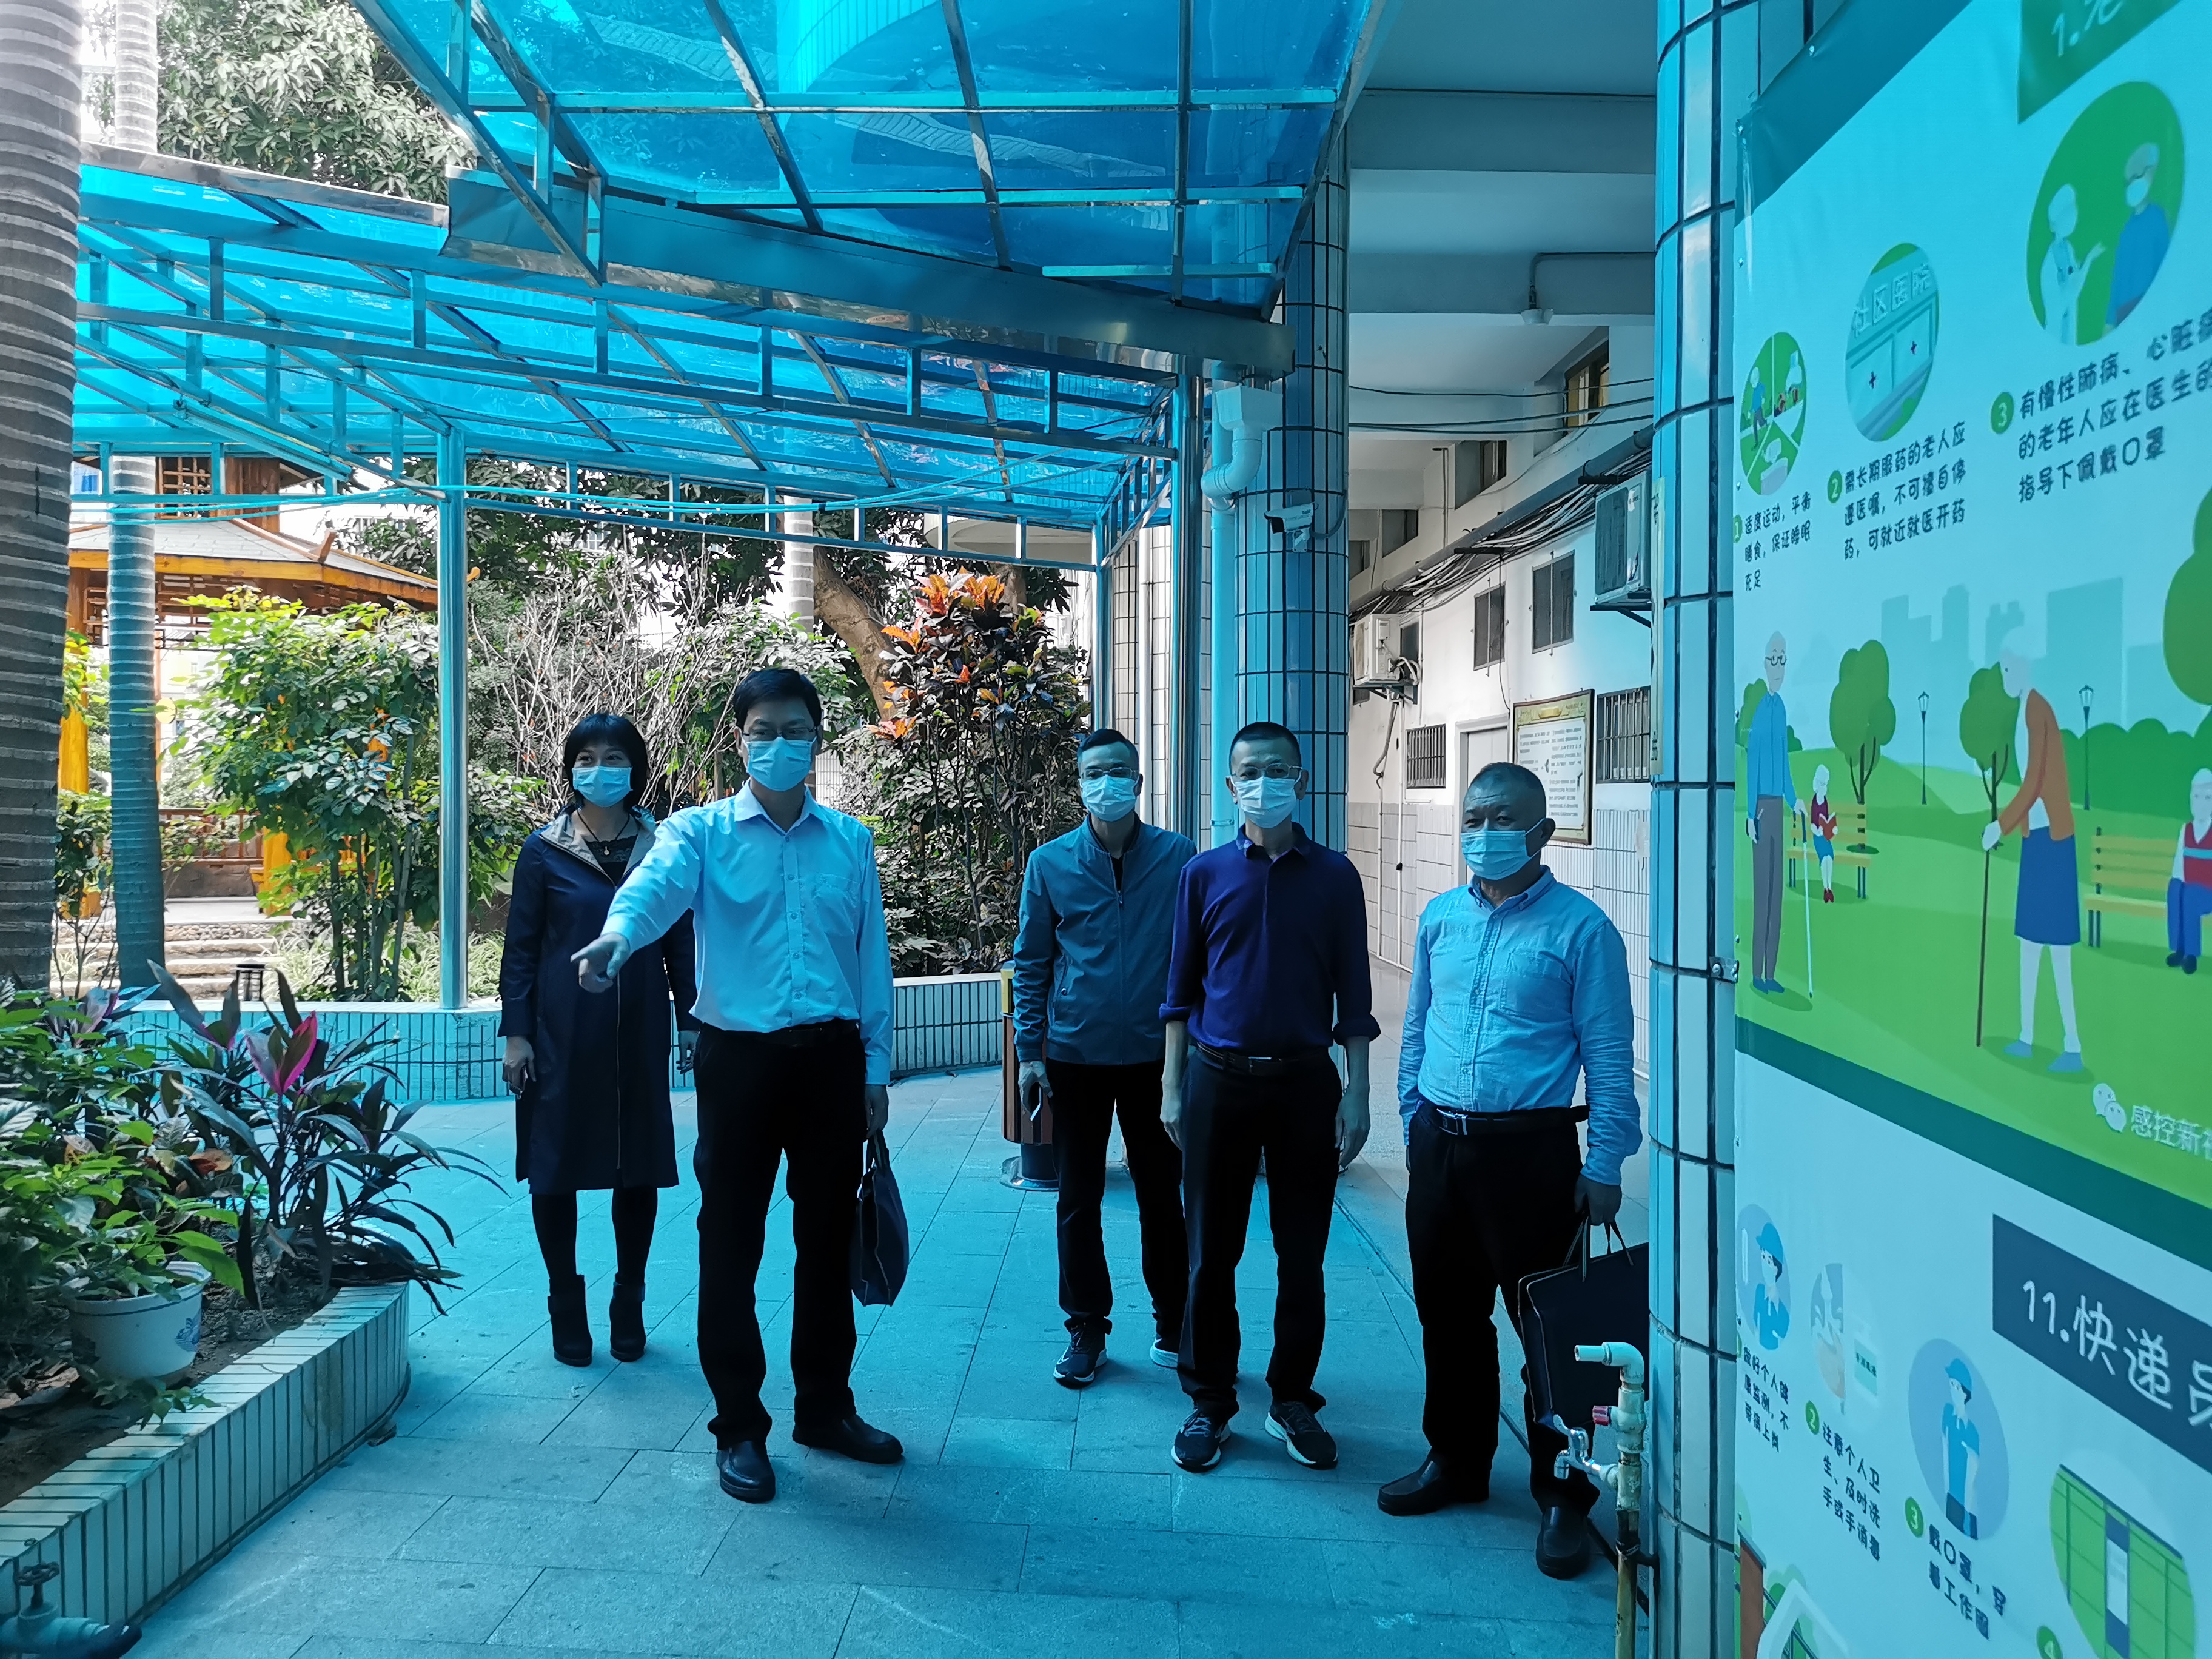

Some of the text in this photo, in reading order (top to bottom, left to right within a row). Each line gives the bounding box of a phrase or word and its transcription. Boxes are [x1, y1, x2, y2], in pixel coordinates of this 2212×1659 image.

[1852, 263, 1930, 338] 社区医院
[1997, 402, 2008, 427] 3
[1845, 420, 1965, 494] 需长期服药的老人应
[2019, 426, 2165, 503] 指导下佩戴口罩
[1831, 478, 1839, 500] 2
[1745, 569, 1761, 591] 充足
[1810, 1407, 1816, 1430] 2
[1822, 1421, 1880, 1495] 注意个人卫
[1911, 1506, 1918, 1530] 3
